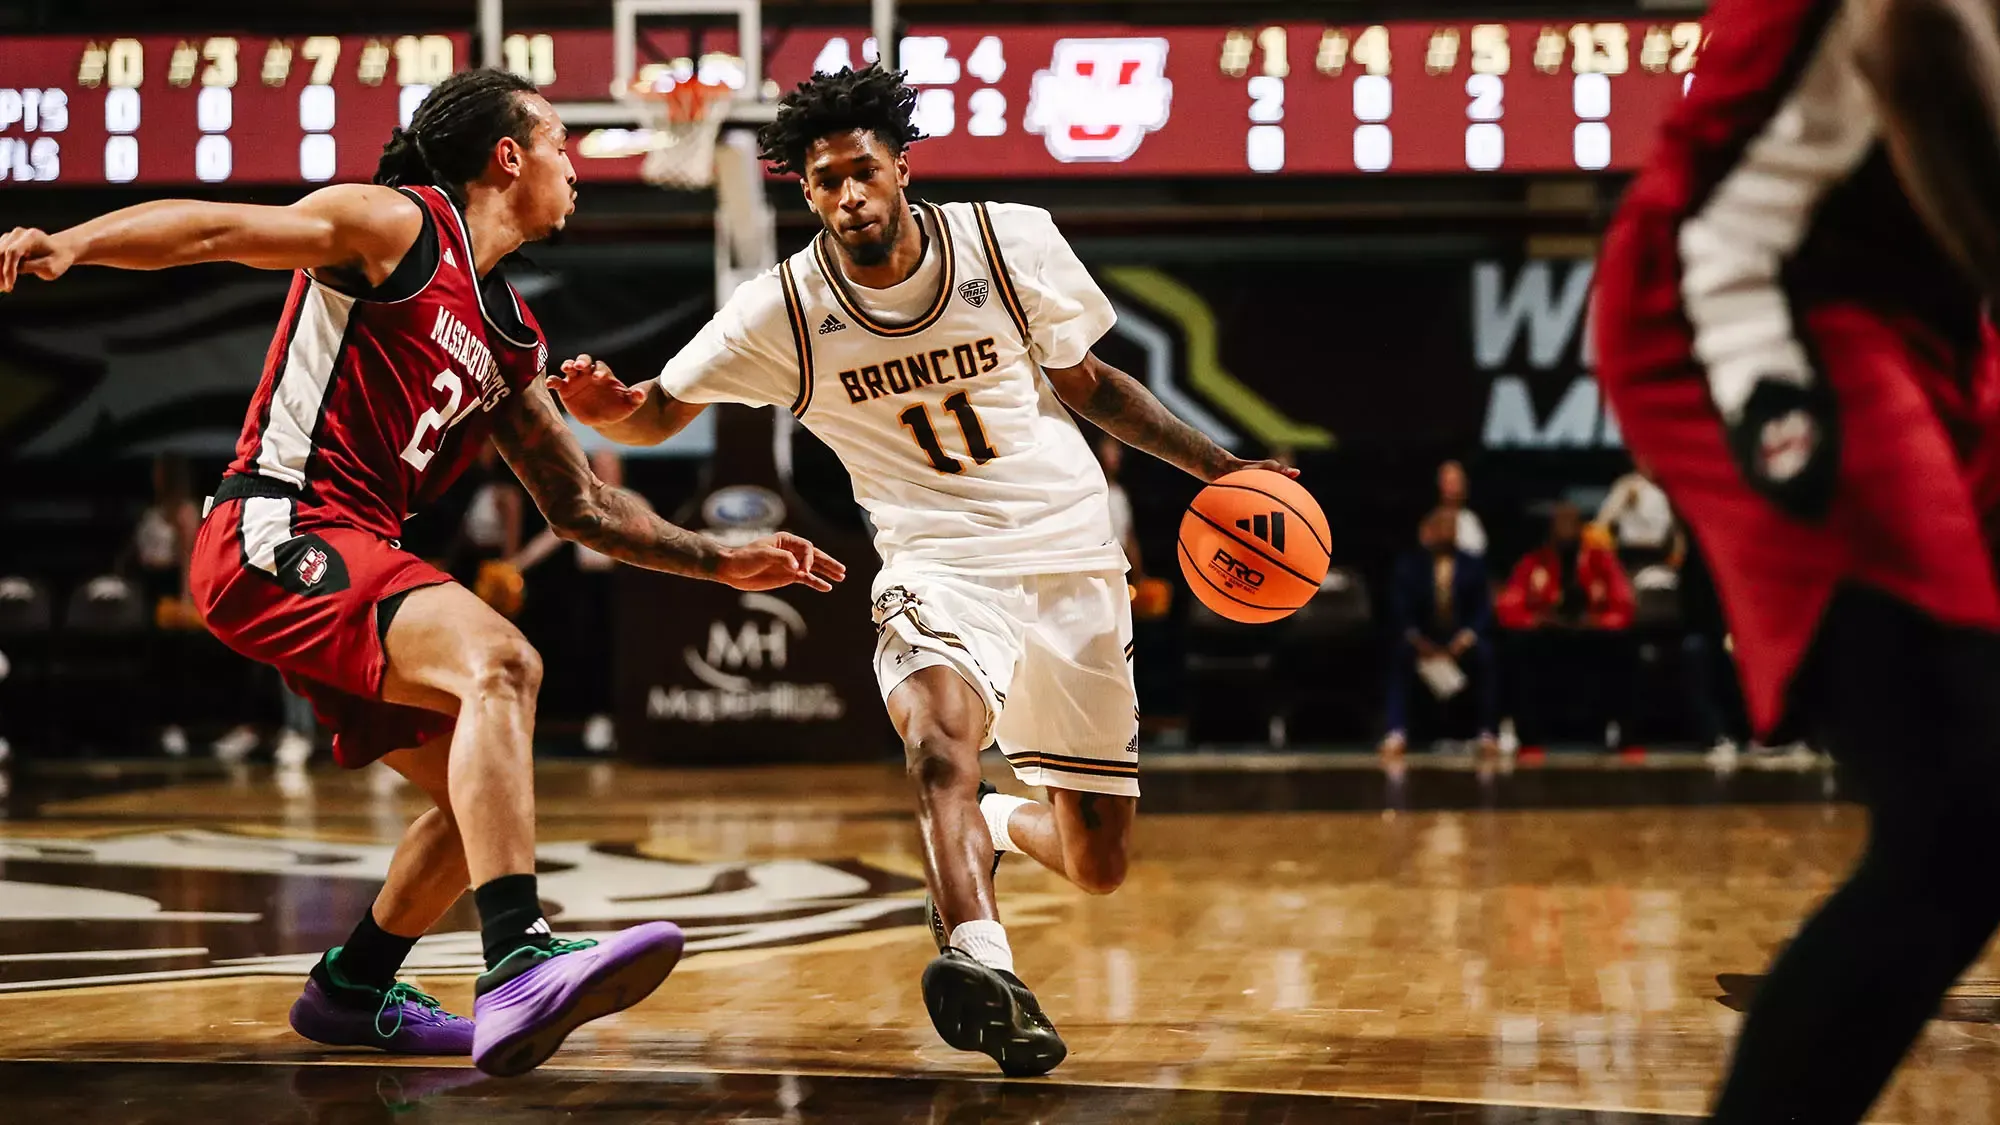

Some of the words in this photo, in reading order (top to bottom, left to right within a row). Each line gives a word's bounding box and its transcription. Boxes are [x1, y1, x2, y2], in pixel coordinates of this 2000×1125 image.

[169, 37, 240, 88] #3
[261, 36, 341, 88] #7
[1220, 26, 1290, 77] #1
[1316, 25, 1392, 77] #4
[1425, 24, 1511, 76] #5
[1534, 23, 1629, 76] #13
[1247, 75, 1286, 123] 2
[1465, 73, 1505, 122] 2
[819, 322, 847, 335] adidas
[839, 337, 999, 404] BRONCOS
[897, 388, 1000, 476] 11
[1213, 548, 1265, 587] PRO
